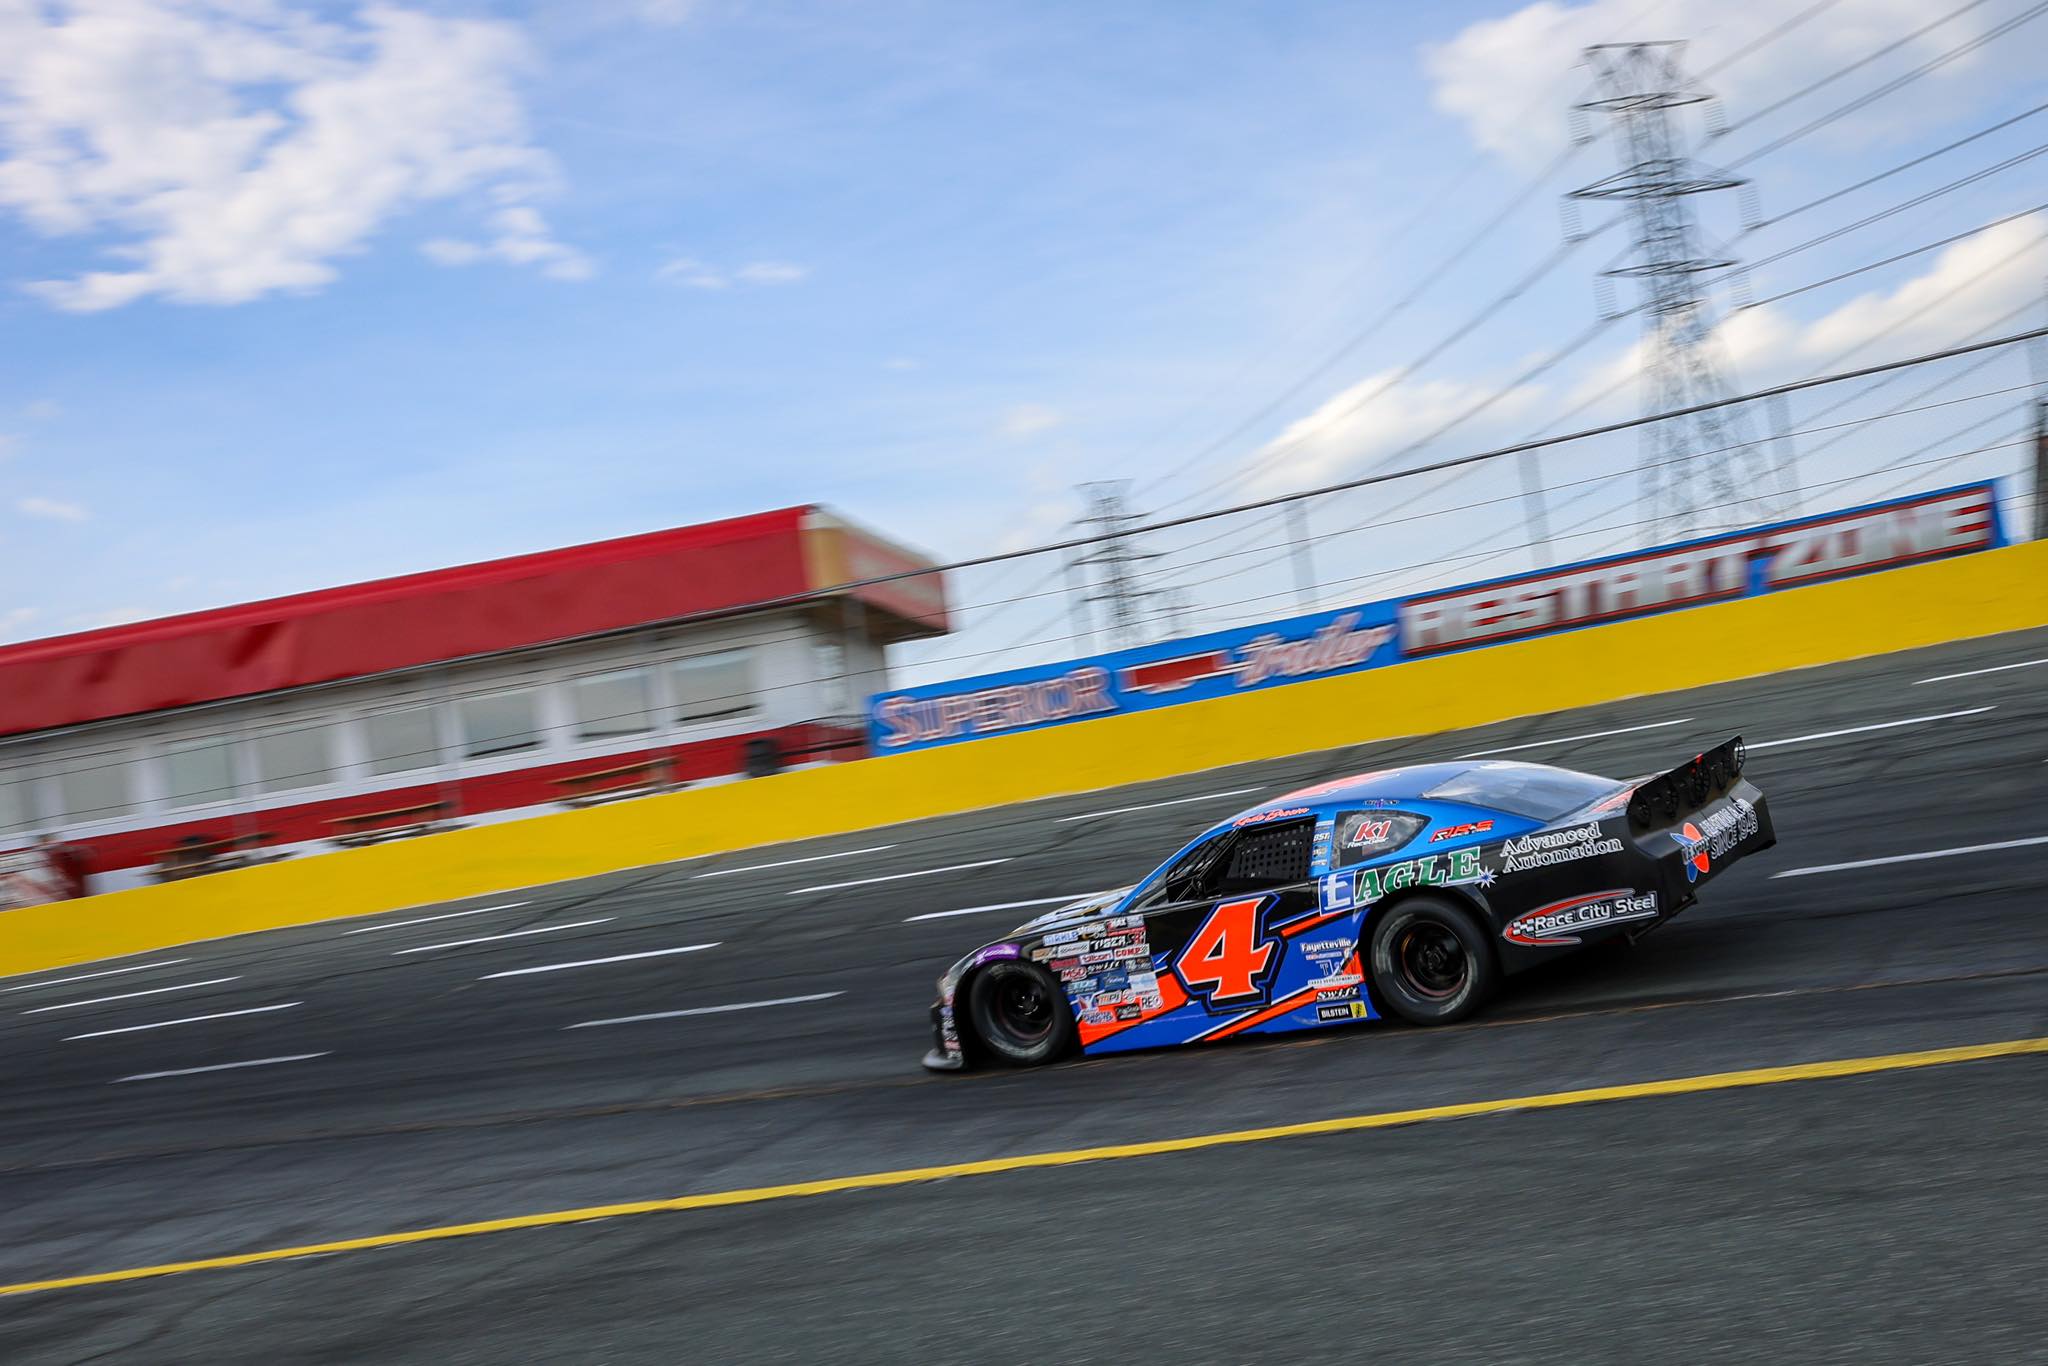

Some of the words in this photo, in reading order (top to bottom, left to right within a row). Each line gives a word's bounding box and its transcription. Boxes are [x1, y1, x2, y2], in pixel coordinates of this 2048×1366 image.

[1403, 551, 1748, 651] RESTART
[1764, 492, 1990, 584] ZONE
[877, 665, 1121, 749] SUPERIOR
[1354, 820, 1392, 842] K1
[1500, 821, 1602, 858] Advanced
[1503, 838, 1624, 874] Automation
[1322, 846, 1481, 912] EAGLE
[1535, 913, 1576, 931] Race
[1579, 904, 1611, 923] City
[1614, 893, 1655, 914] Steel
[1176, 895, 1276, 1002] 4
[1301, 938, 1352, 953] Fayetteville
